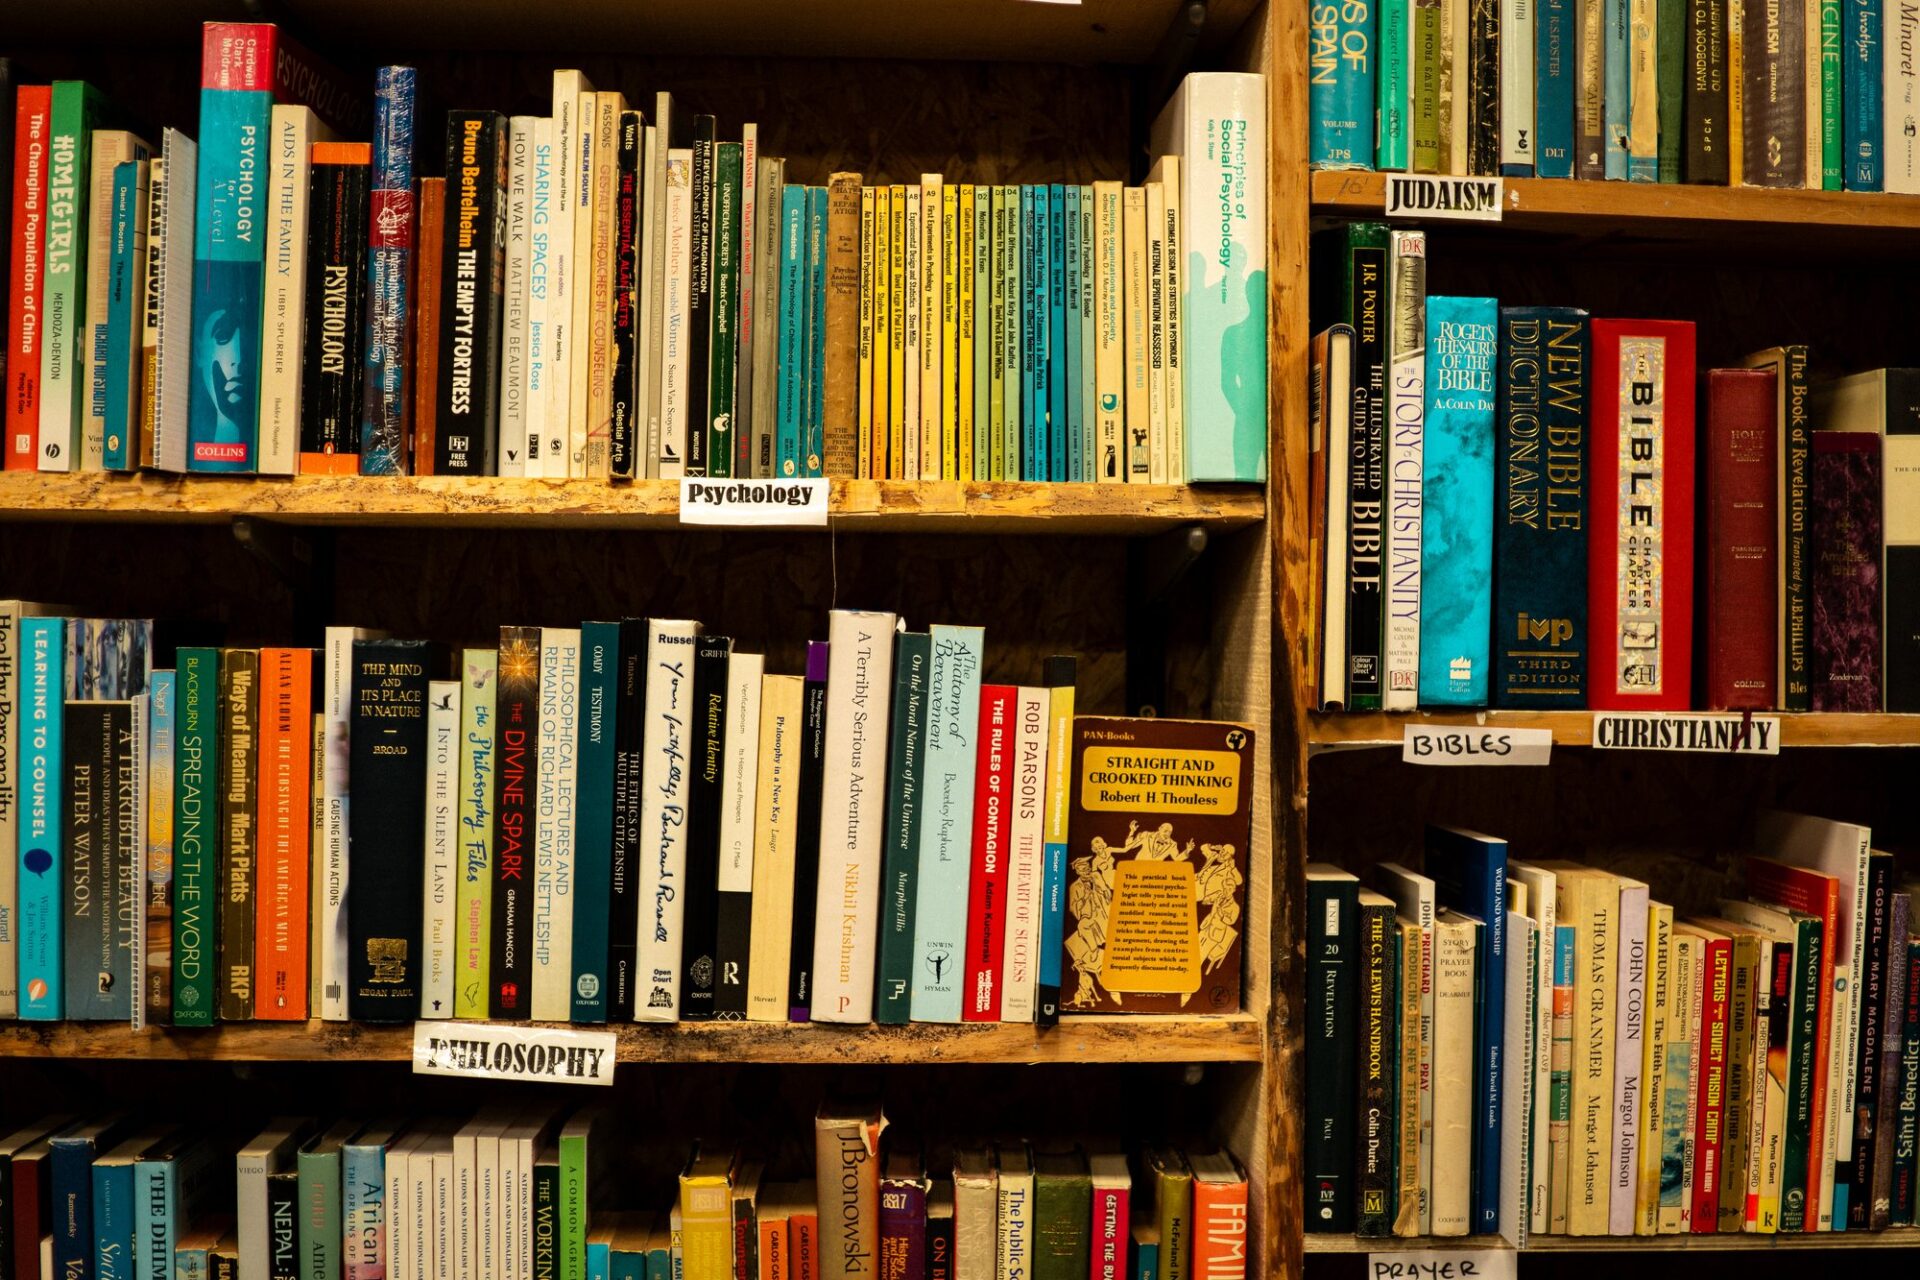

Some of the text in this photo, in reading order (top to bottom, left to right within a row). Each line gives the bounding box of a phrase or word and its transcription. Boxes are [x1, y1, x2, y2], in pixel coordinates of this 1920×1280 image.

[1311, 5, 1339, 85] SPAIN
[1342, 31, 1368, 74] OF
[1697, 9, 1707, 91] HANDBOOK TO
[1711, 1, 1722, 92] OLD TESTAMENT
[1856, 10, 1877, 63] brother
[1900, 3, 1919, 77] Minaret
[625, 125, 635, 150] Watts
[1235, 120, 1247, 220] Principles of
[1328, 149, 1352, 160] JPS
[49, 135, 75, 274] HOMEGIRLS
[236, 126, 257, 243] PSYCHOLOGY
[277, 121, 296, 277] AIDS IN THE FAMILY
[1218, 120, 1233, 269] Social Psychology
[1389, 177, 1497, 212] JUDAISM
[22, 113, 43, 354] The Changing Population of China
[530, 144, 550, 300] SHARING SPACES?
[1401, 238, 1423, 254] DK
[451, 120, 483, 415] Bruno Bettelheim THE EMPTY FORTRESS
[51, 293, 63, 380] MENDOZA-DENTON
[321, 265, 349, 376] PSYCHOLOGY
[1152, 239, 1162, 369] MATERNAL DEPRIVATION REASSESSED
[1362, 263, 1377, 343] J.R. PORTER
[1439, 321, 1496, 342] ROGET'S
[1434, 338, 1497, 356] THESAURUS
[1437, 369, 1492, 393] BIBLE
[1442, 354, 1489, 370] OF THE
[614, 401, 626, 462] Celestial Arts
[1395, 376, 1423, 452] STORY
[1508, 319, 1541, 530] DICTIONARY
[1546, 320, 1582, 530] NEW BIBLE
[1792, 353, 1808, 532] The Book of Revelation
[197, 446, 244, 457] COLLINS
[449, 460, 468, 468] PRESS
[1630, 382, 1654, 527] BIBLE
[687, 483, 814, 506] Psychology
[1352, 499, 1381, 594] BIBLE
[1391, 457, 1422, 623] CHRISTIANITY
[1517, 612, 1574, 647] ivp
[1519, 660, 1571, 669] THIRD
[361, 690, 422, 702] ITS PLACE
[362, 664, 422, 676] THE MIND
[381, 678, 401, 687] AND
[1508, 674, 1580, 683] EDITION
[1789, 681, 1807, 693] Bles
[32, 629, 47, 838] LEARNING TO COUNSEL
[361, 706, 421, 717] IN NATURE
[846, 631, 871, 850] A Terribly Serious Adventure
[1083, 730, 1135, 740] PAN-Books
[1412, 734, 1512, 756] BIBLES
[1598, 717, 1772, 750] CHRISTIANITY
[228, 669, 251, 903] Ways of Meaning Mark Platts
[500, 703, 525, 881] THE DIVINE SPARK
[984, 699, 1004, 874] THE RULES OF CONTAGION
[1020, 701, 1041, 820] ROB PARSONS
[1089, 771, 1234, 788] CROOKED THINKING
[1106, 756, 1215, 771] STRAIGHT AND
[181, 657, 202, 979] BLACKBURN SPREADING THE WORD
[1099, 790, 1218, 806] Robert H. Thouless
[231, 965, 250, 1000] RKP
[654, 969, 671, 977] Open
[1325, 970, 1337, 1039] REVELATION
[1369, 916, 1383, 1080] THE C. S. LEWIS HANDBOOK
[1588, 909, 1607, 1080] THOMAS CRANMER
[1626, 939, 1644, 1040] JOHN COSIN
[1713, 950, 1727, 1003] LETTERS
[427, 1037, 605, 1078] PHILOSOPHY
[1704, 1022, 1724, 1145] SOVIET PRISON CAMP
[1899, 1038, 1920, 1111] Benedict
[1368, 1108, 1380, 1174] Colin Duriez
[1897, 1117, 1915, 1159] Saint
[274, 1201, 293, 1272] NEPAL:
[363, 1182, 382, 1265] African
[569, 1178, 577, 1234] COMMON
[1009, 1189, 1025, 1261] The Public
[1103, 1194, 1117, 1261] GETTING THE
[1374, 1260, 1480, 1280] PRAYER
